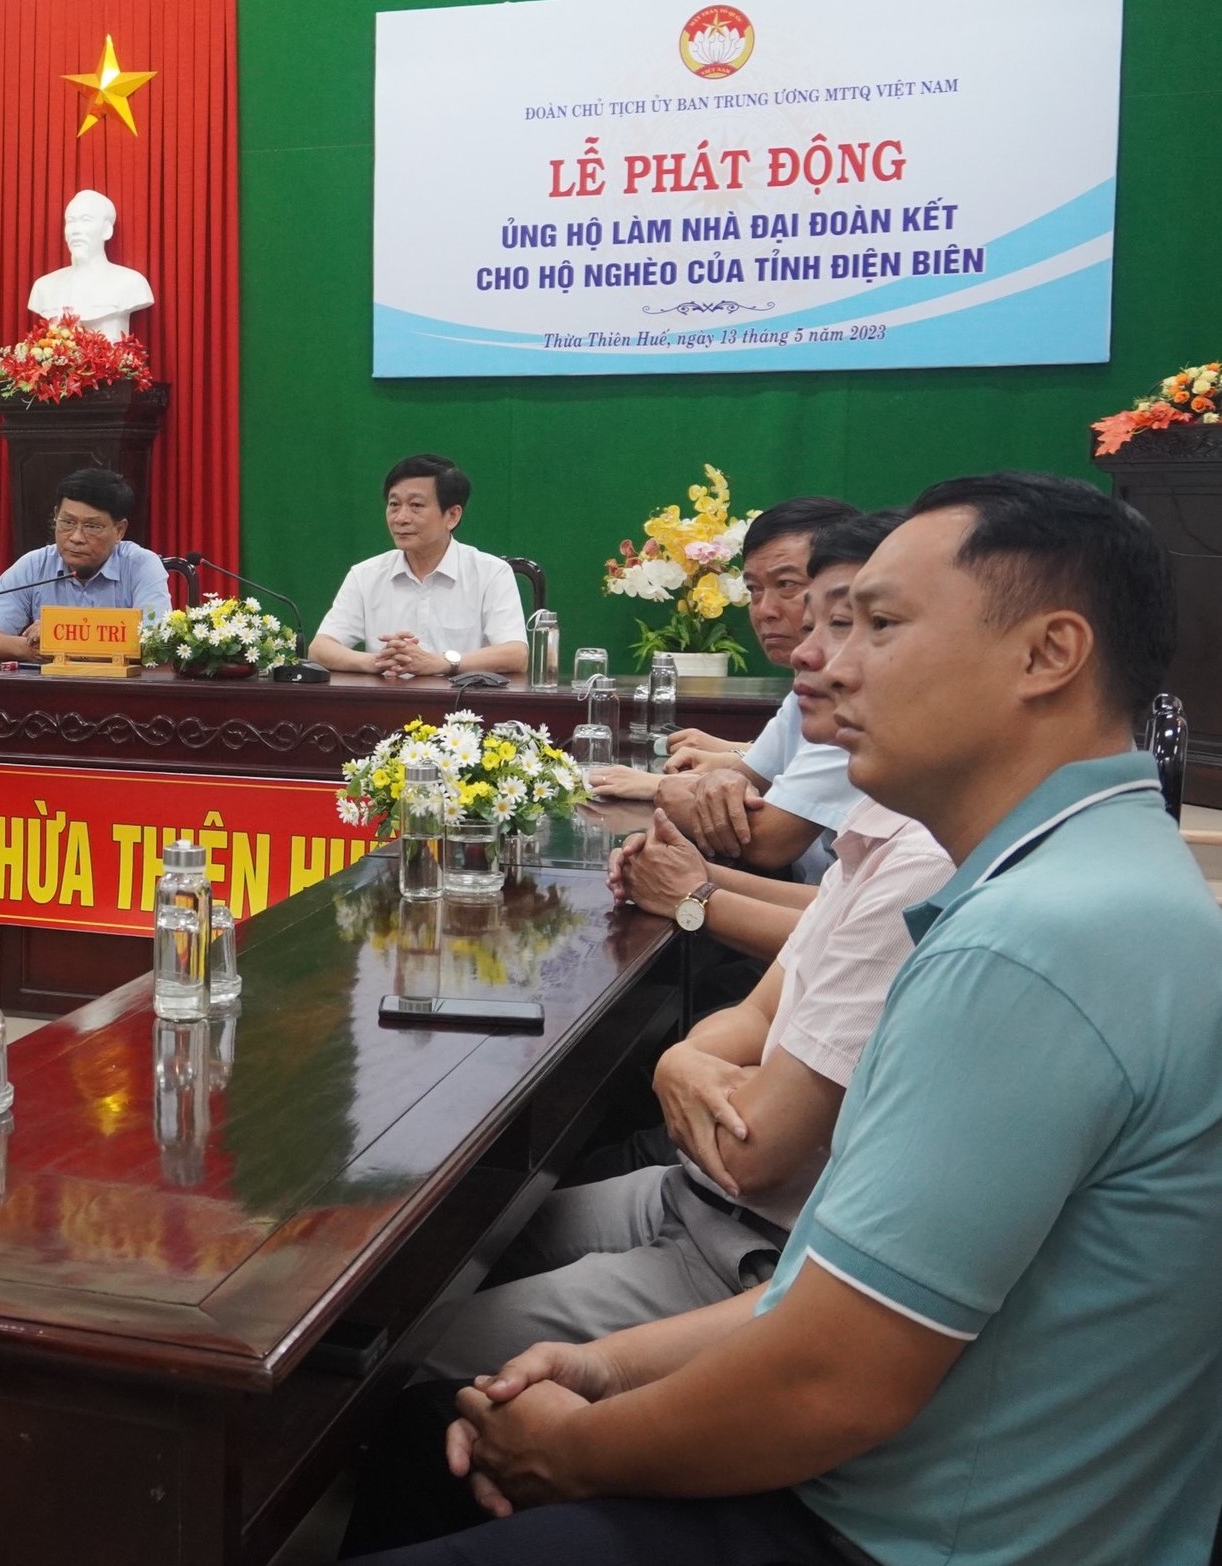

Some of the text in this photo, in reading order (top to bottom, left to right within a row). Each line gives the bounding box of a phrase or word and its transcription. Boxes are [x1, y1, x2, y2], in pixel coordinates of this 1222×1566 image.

[525, 78, 959, 121] ĐOÀN CHỦ TỊCH ỦY BAN TRUNG ƯƠNG MTTQ VIỆT NAM
[549, 133, 907, 198] LỄ PHÁT ĐỘNG
[501, 197, 958, 251] ỦNG HỘ LÀM NHÀ ĐẠI ĐOÀN KẾT
[476, 243, 985, 294] CHO HỘ NGHÈO CỦA TỈNH ĐIỆN BIÊN
[543, 324, 887, 349] Thừa Thiên Huế, ngày 13 tháng 5 năm 2023
[53, 617, 127, 643] CHỦ TRÌ
